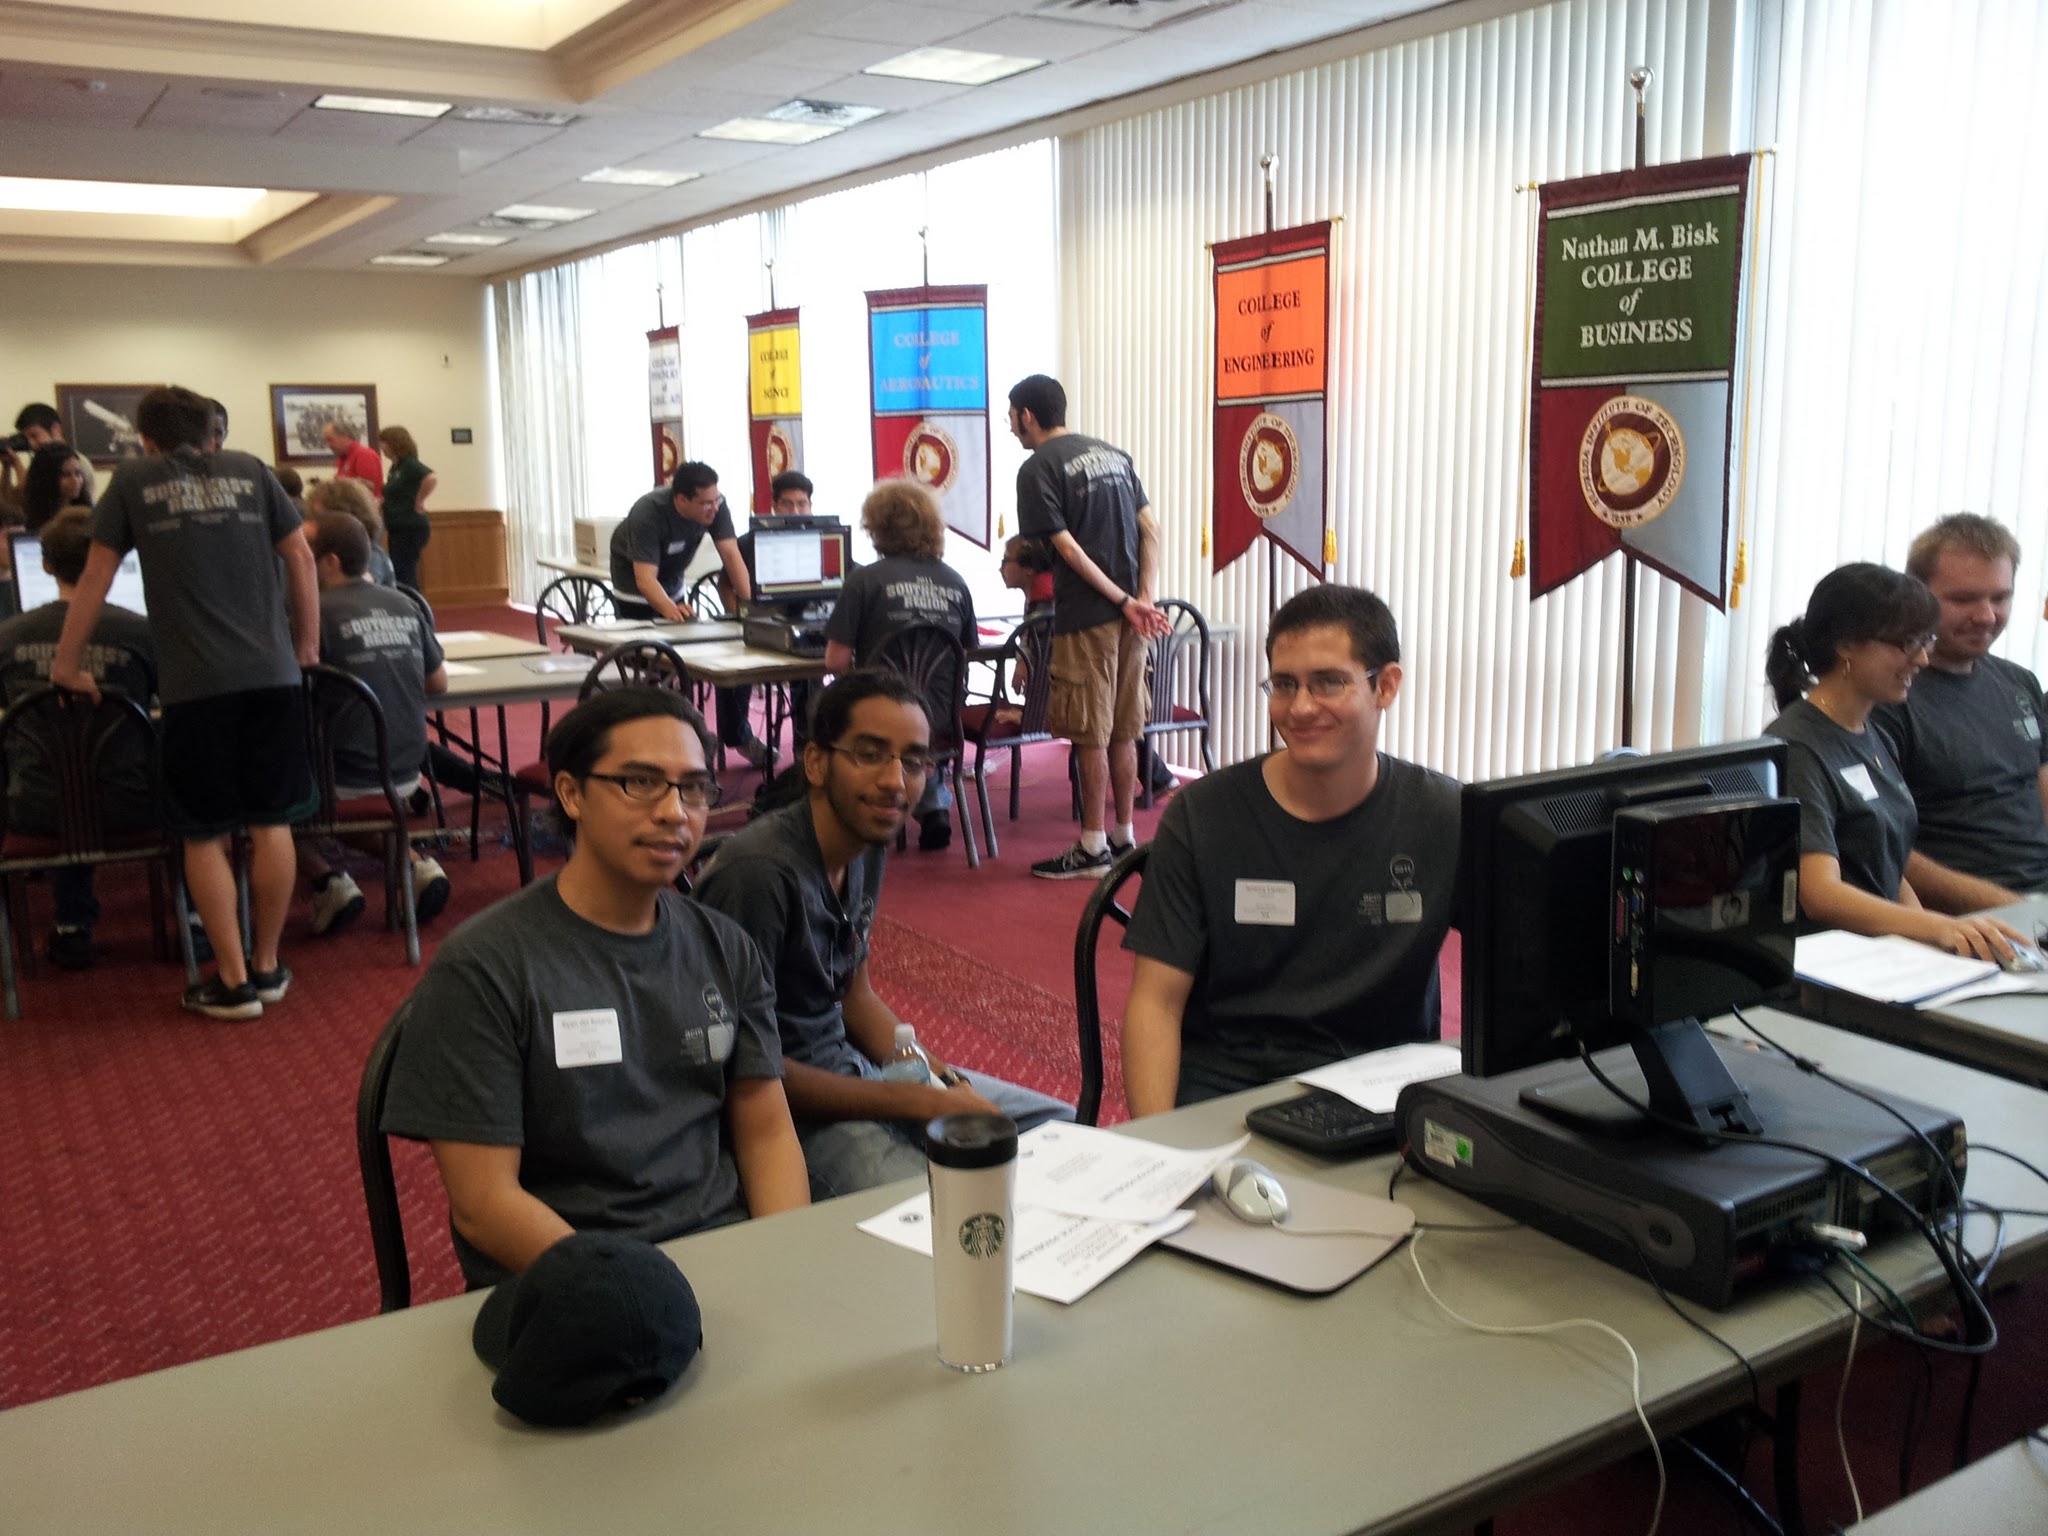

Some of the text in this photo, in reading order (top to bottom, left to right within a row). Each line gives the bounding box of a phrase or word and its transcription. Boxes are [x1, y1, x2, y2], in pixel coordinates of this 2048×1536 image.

[1561, 221, 1720, 261] Nathan M. Bisk
[1581, 256, 1692, 289] COLLEGE
[1238, 290, 1301, 316] COLLEGE
[1619, 287, 1643, 316] of
[893, 331, 960, 348] COLLEGE
[1261, 320, 1275, 343] of
[1580, 317, 1693, 348] BUSINESS
[1224, 348, 1315, 374] ENGINEERING
[881, 376, 979, 392] AERONAUTICS
